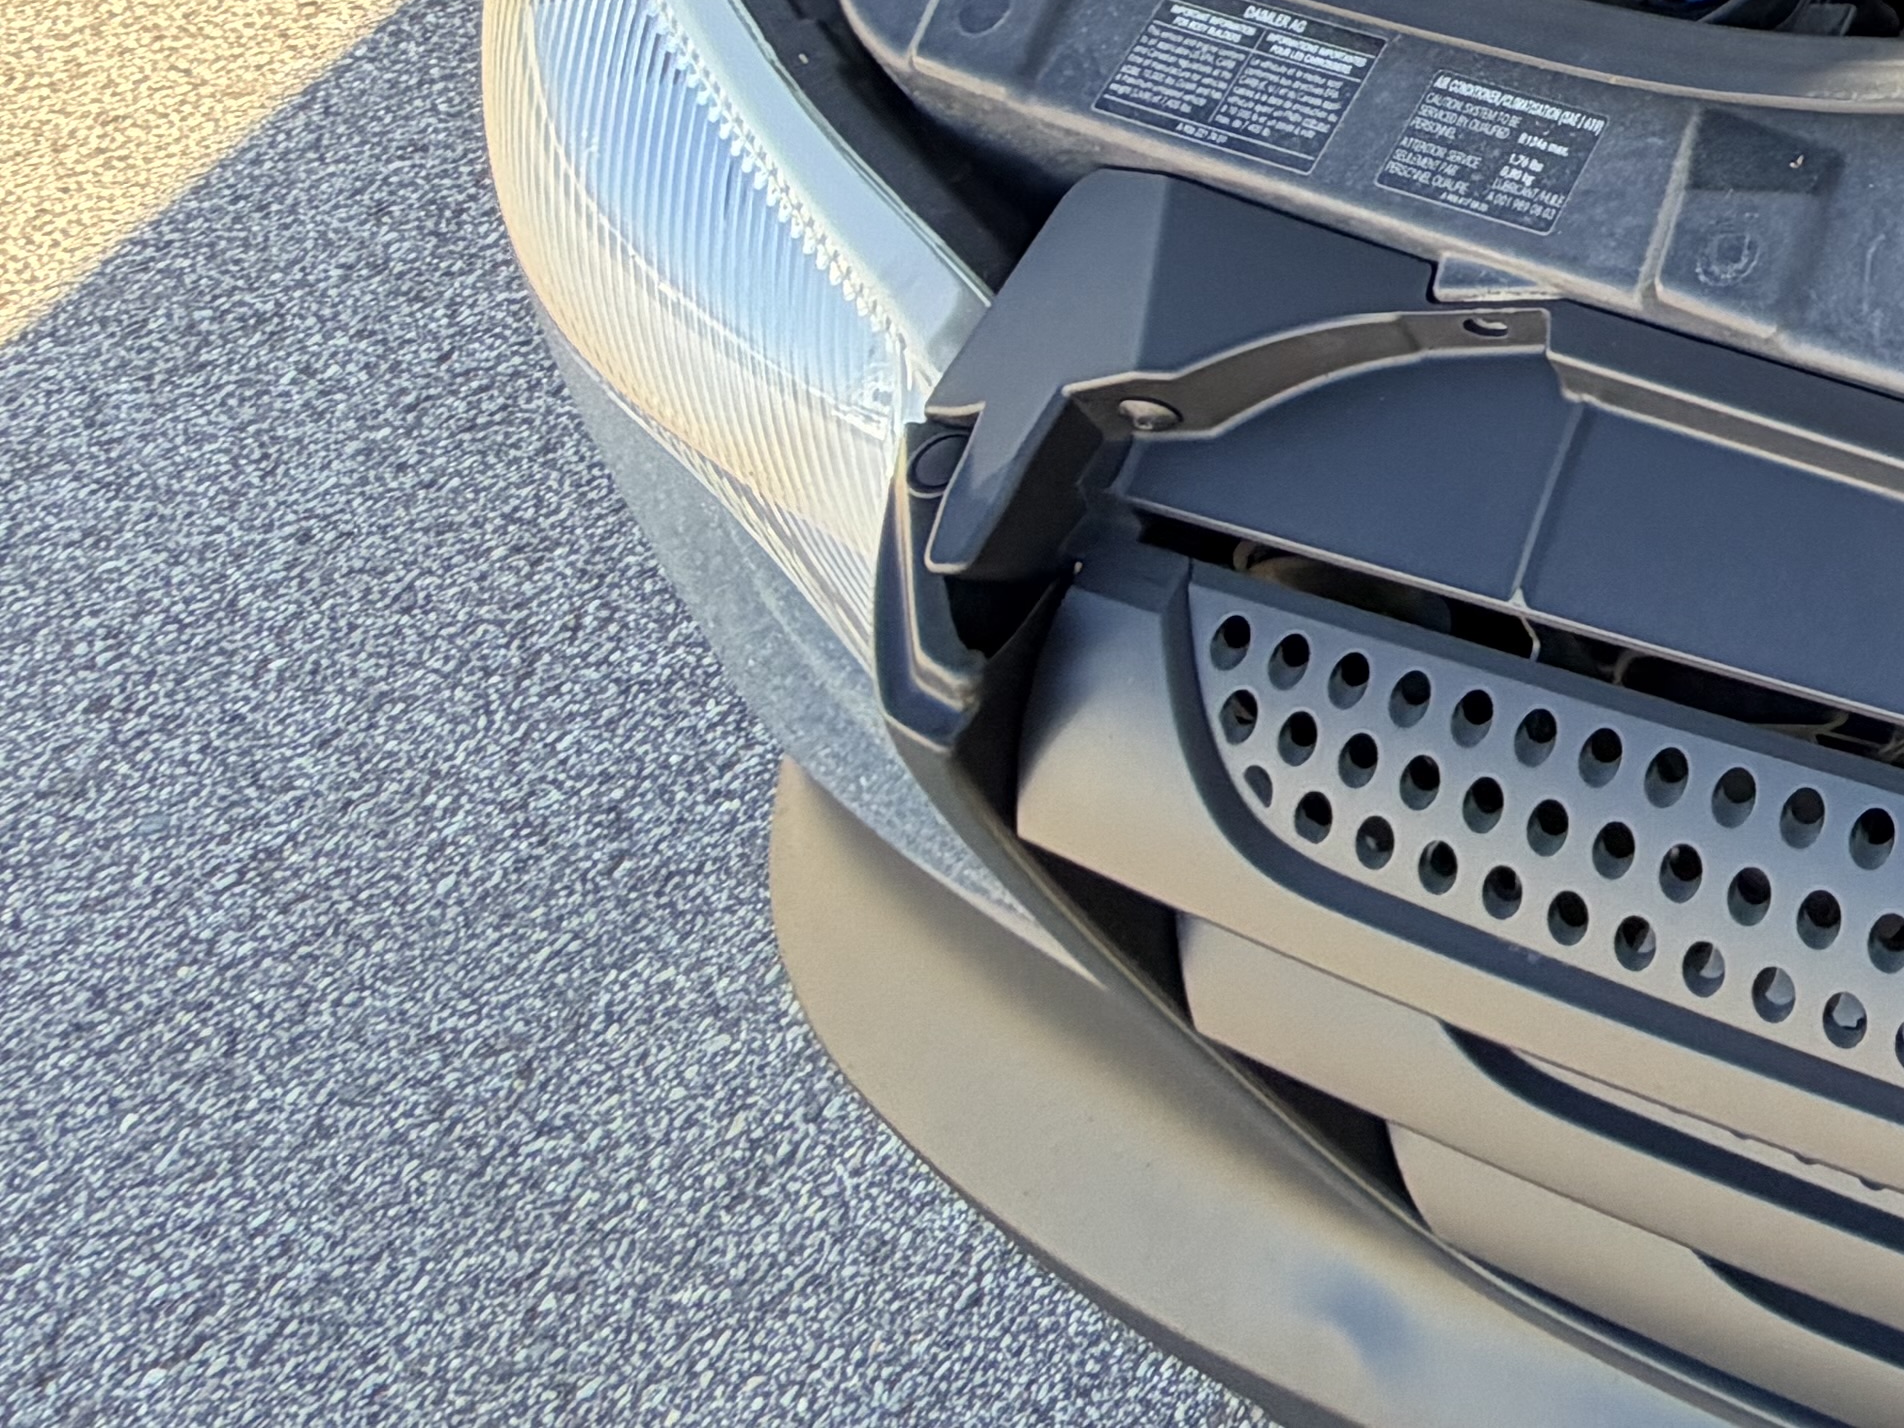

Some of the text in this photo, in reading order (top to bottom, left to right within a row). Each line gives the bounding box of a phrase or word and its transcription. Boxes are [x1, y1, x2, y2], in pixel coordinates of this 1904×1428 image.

[1244, 6, 1307, 33] DAIMLER AG
[1434, 76, 1451, 89] AIR
[1419, 105, 1510, 139] SERVICED BY QUALIFIED
[1463, 103, 1498, 121] SYSTEM
[1498, 112, 1511, 125] TO
[1509, 116, 1522, 128] BE
[1447, 150, 1482, 169] SERVICE
[1486, 192, 1495, 201] A
